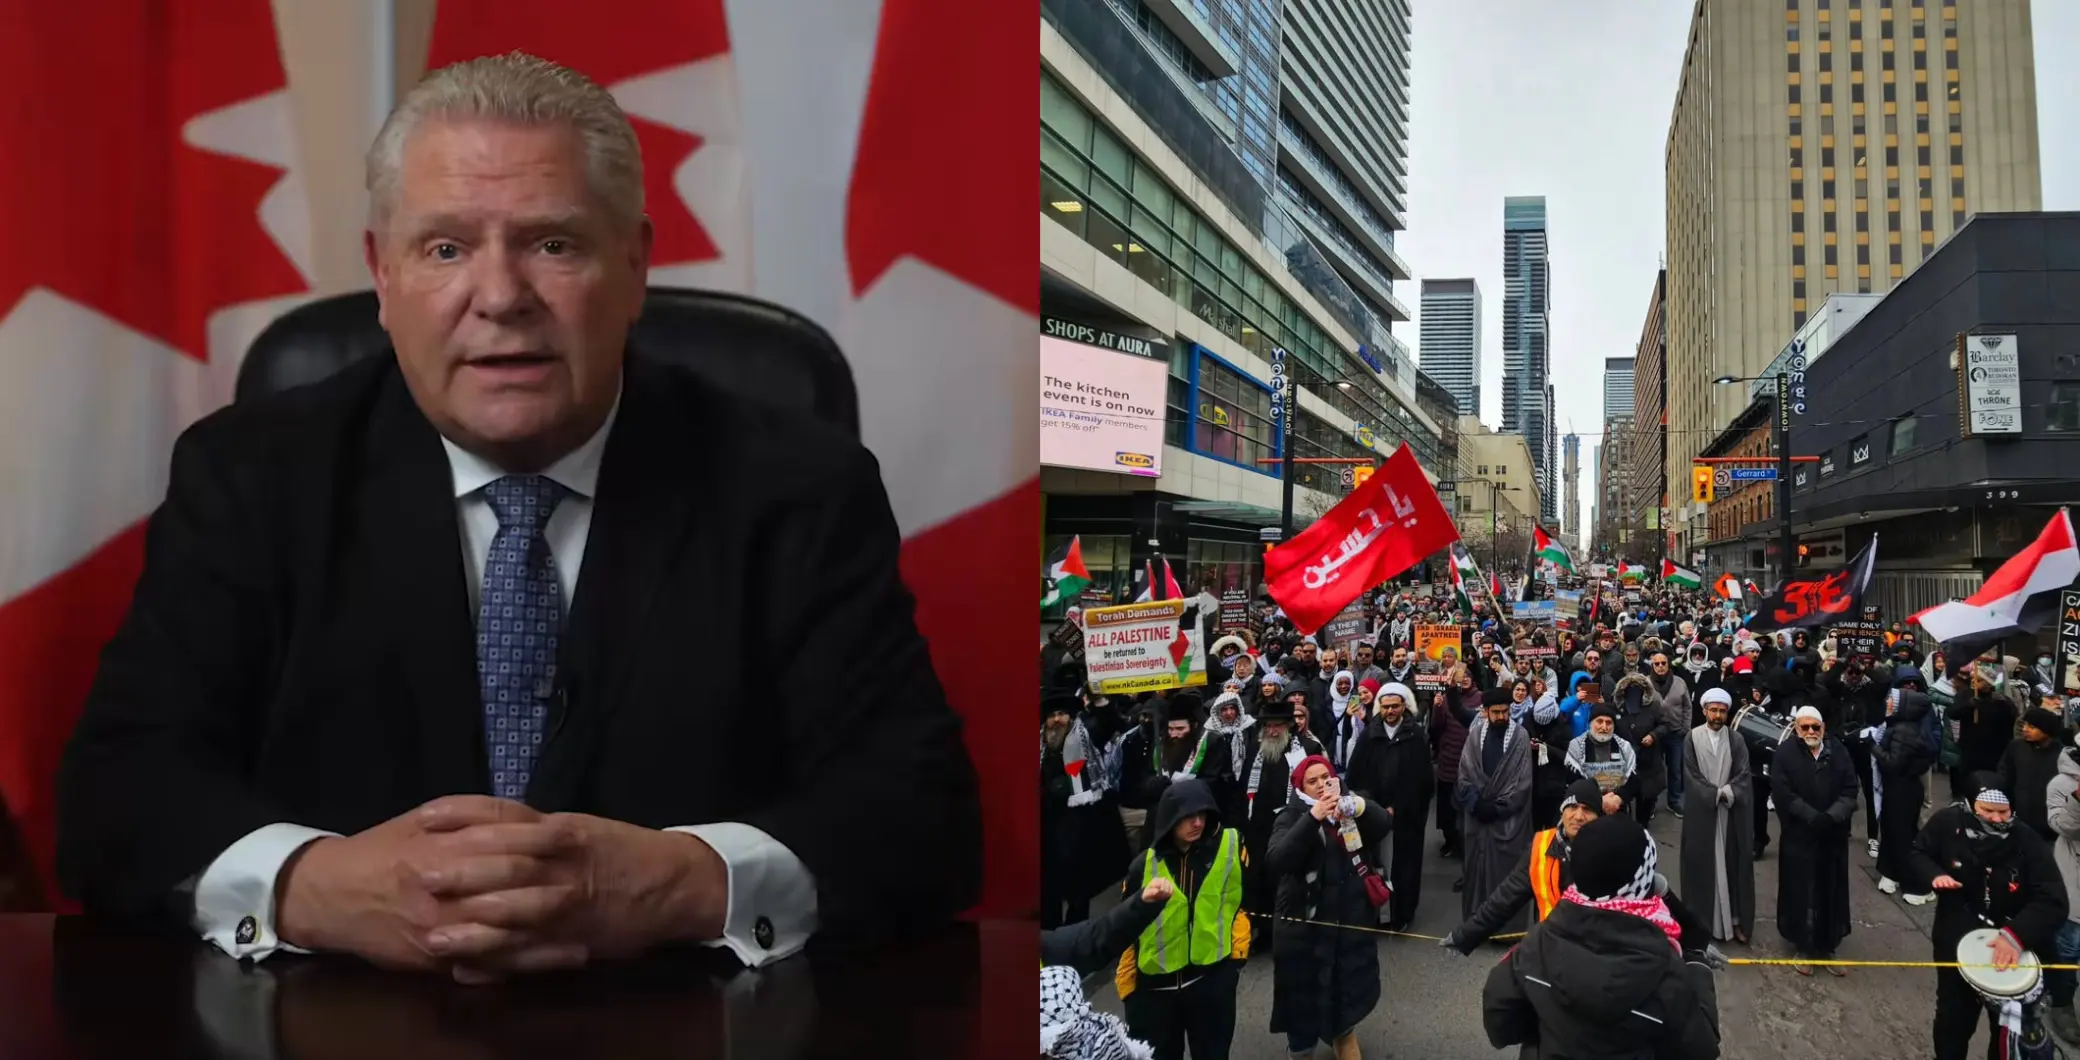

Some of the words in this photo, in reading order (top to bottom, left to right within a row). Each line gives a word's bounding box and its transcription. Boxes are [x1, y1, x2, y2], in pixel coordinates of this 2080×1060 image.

[1046, 319, 1095, 342] SHOPS
[1099, 332, 1115, 347] AT
[1117, 336, 1152, 356] AURA
[1970, 351, 2016, 363] Barclay
[1044, 376, 1072, 390] The
[1077, 382, 1130, 401] kitchen
[1269, 347, 1285, 419] Yonge
[1043, 390, 1087, 405] event
[1091, 397, 1102, 407] is
[1106, 401, 1123, 412] on
[1128, 404, 1155, 417] now
[1978, 396, 2012, 405] THRONE
[1041, 407, 1067, 419] IKEA
[1069, 411, 1103, 426] Family
[1105, 418, 1148, 432] members
[1041, 419, 1058, 428] get
[1061, 421, 1080, 431] 15%
[1119, 455, 1151, 465] IKEA
[1736, 469, 1766, 477] Gerrard
[1303, 508, 1395, 589] حسين
[1096, 612, 1125, 622] Torah
[1127, 606, 1175, 618] Demands
[1334, 627, 1357, 637] NAME
[1337, 620, 1360, 629] THEIR
[2062, 622, 2080, 637] ZI
[1088, 633, 1108, 648] ALL
[1110, 626, 1171, 646] PALESTINE
[1841, 637, 1849, 645] IS
[1104, 650, 1112, 658] be
[1112, 647, 1138, 658] returned
[1138, 647, 1146, 655] to
[2062, 640, 2080, 655] IS
[1089, 661, 1124, 673] Palestinian
[1126, 657, 1167, 670] Sovereignty
[1106, 678, 1172, 689] www.nkCanada.ca
